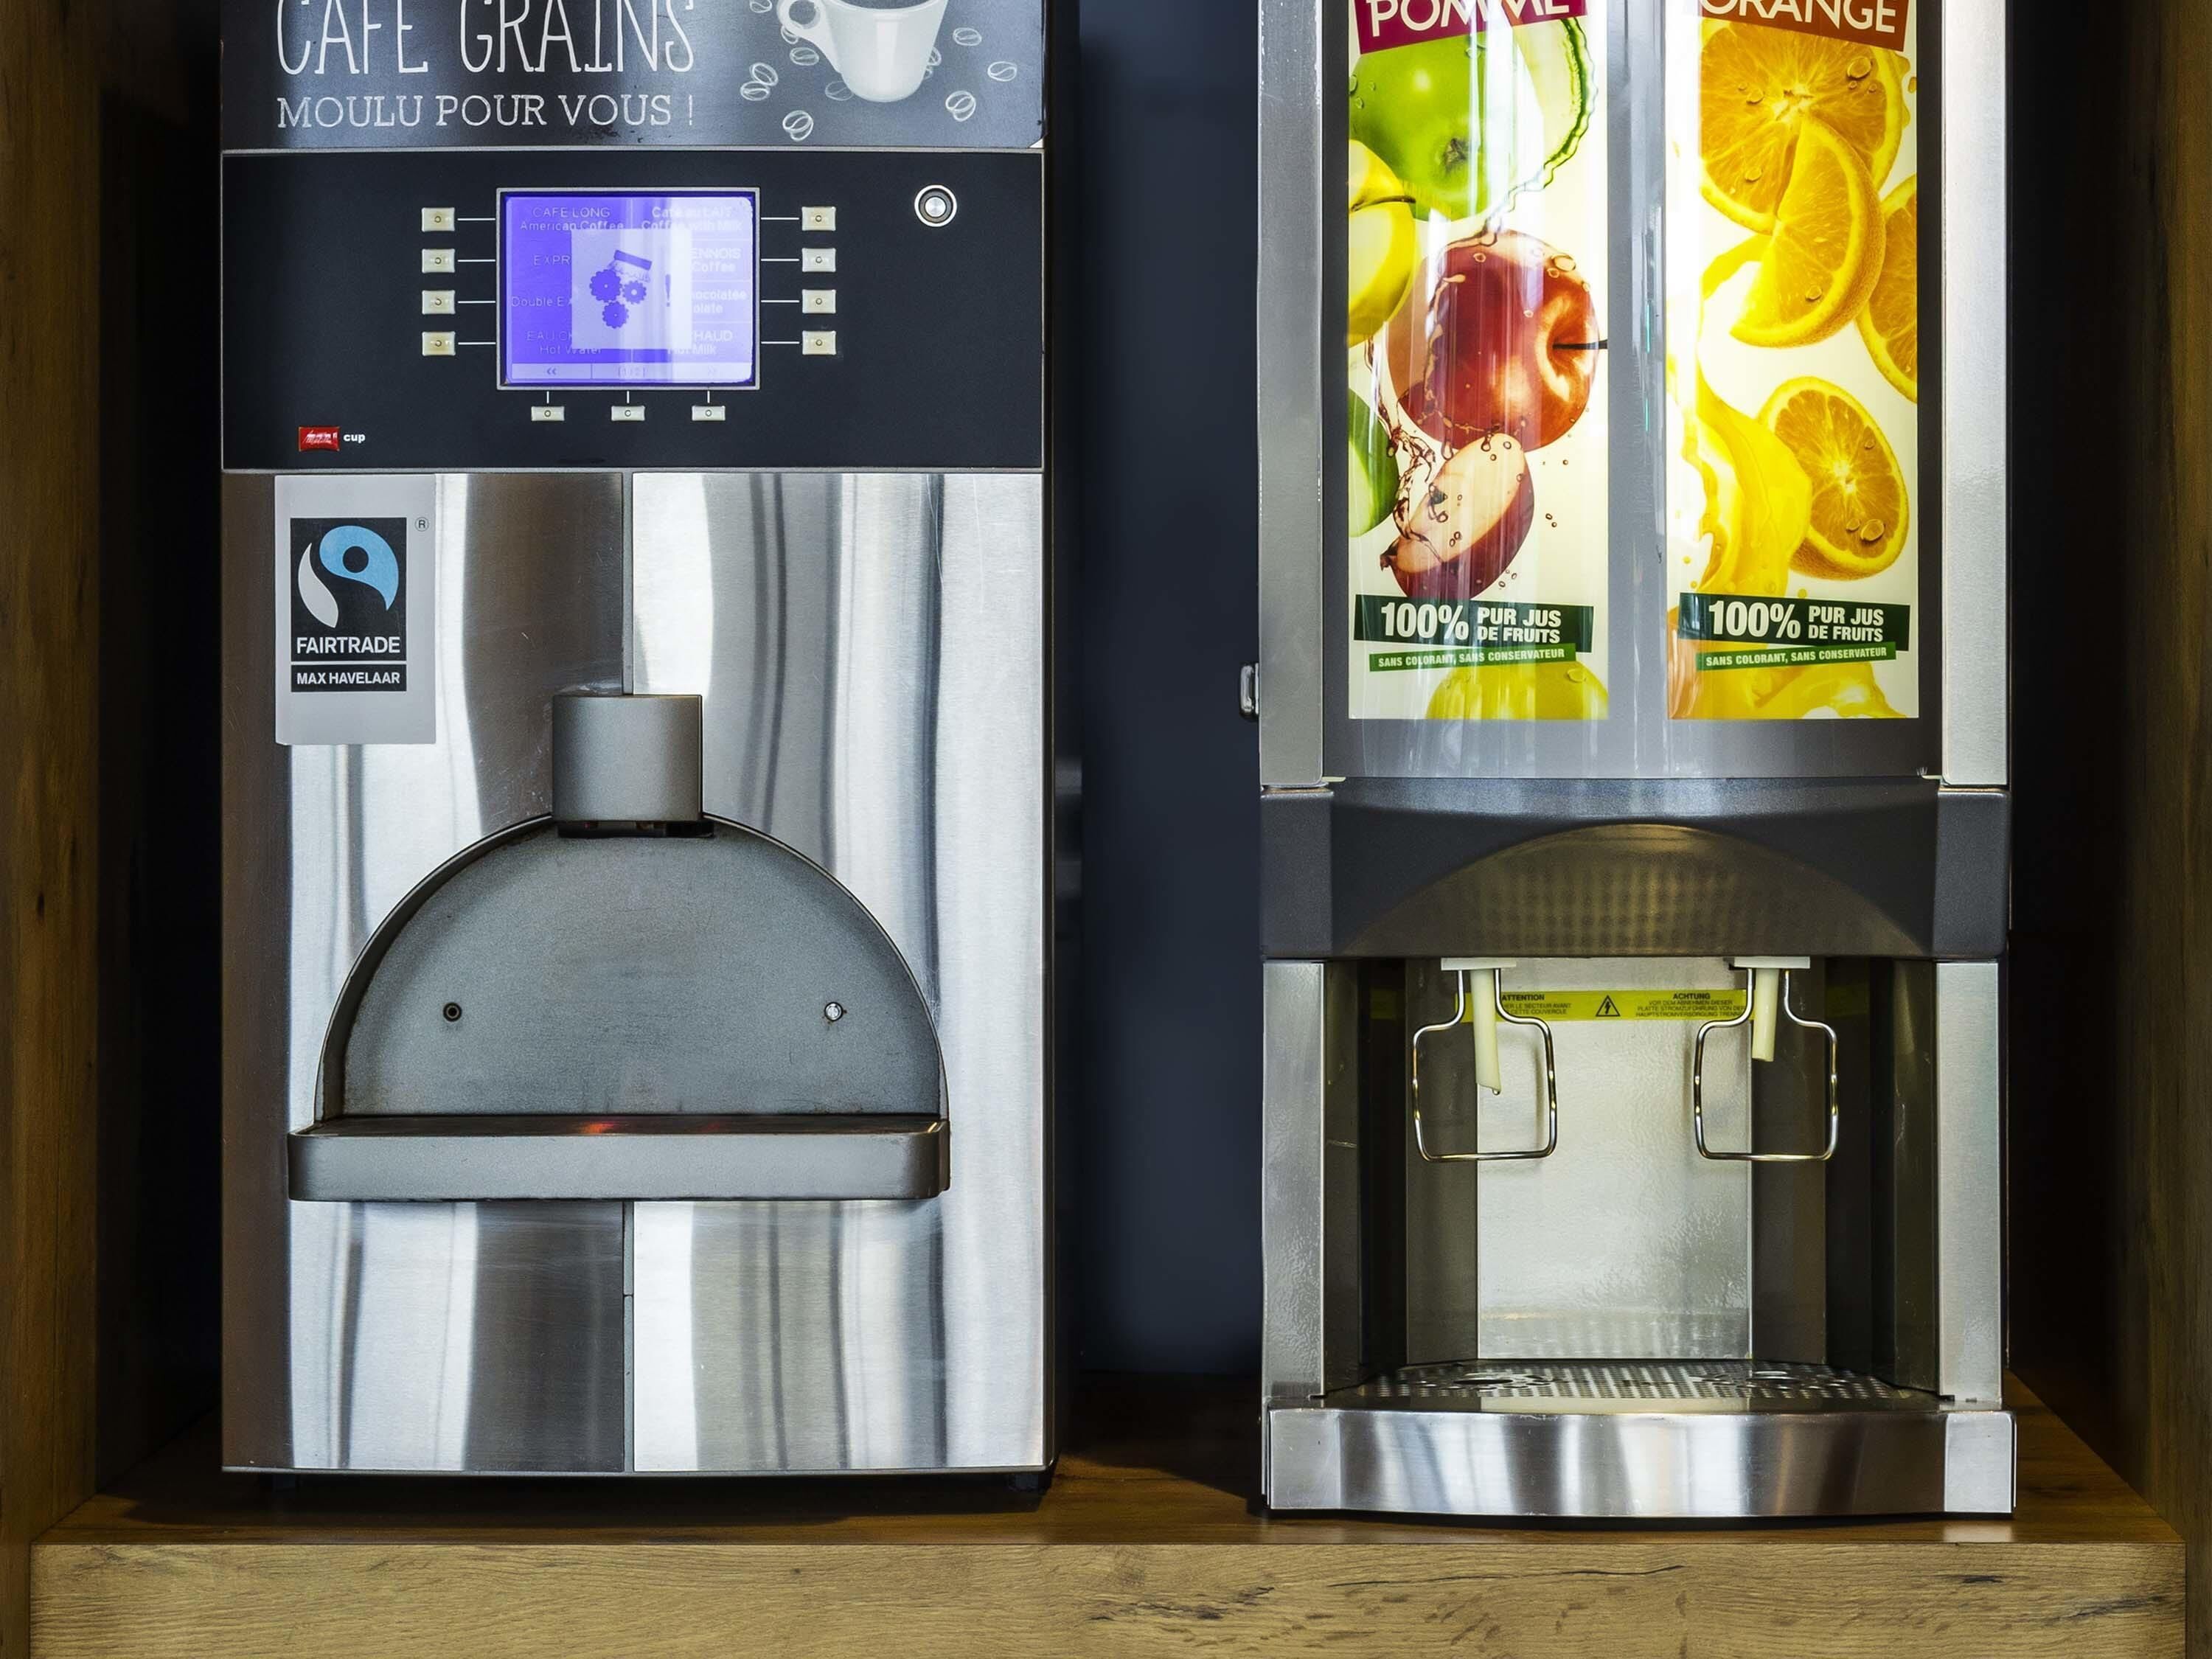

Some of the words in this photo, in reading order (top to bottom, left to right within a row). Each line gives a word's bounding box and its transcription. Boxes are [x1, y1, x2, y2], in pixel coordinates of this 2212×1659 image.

[459, 0, 694, 73] GRAINS
[277, 97, 423, 128] MOULU
[435, 95, 547, 127] POUR
[557, 94, 672, 126] VOUS
[532, 207, 568, 218] CAFE
[572, 207, 611, 218] LONG
[520, 221, 577, 231] American
[580, 220, 625, 230] Coffee
[533, 255, 571, 265] EXPR
[690, 248, 742, 258] ENNOIS
[512, 296, 553, 307] Double
[692, 330, 733, 341] HAUD
[343, 434, 366, 444] cup
[1380, 602, 1469, 641] 100%
[1477, 607, 1517, 626] PUR
[1523, 610, 1562, 627] JUS
[1709, 600, 1801, 639] 100%
[1808, 605, 1845, 624] PUR
[1850, 608, 1885, 626] JUS
[1477, 626, 1499, 641] DE
[1503, 627, 1561, 644] FRUITS
[1808, 625, 1828, 639] DE
[1832, 625, 1884, 642] FRUITS
[296, 636, 400, 654] FAIRTRADE
[1378, 657, 1403, 668] SANS
[1405, 653, 1457, 667] COLORANT,
[1458, 653, 1486, 664] SANS
[1488, 648, 1565, 662] CONSERVATEUR
[1705, 655, 1733, 667] SANS
[1735, 653, 1789, 665] COLORANT,
[1790, 651, 1816, 662] SANS
[1819, 646, 1888, 661] CONSERVATEUR
[296, 672, 327, 684] MAX
[329, 672, 400, 684] HAVELAAR
